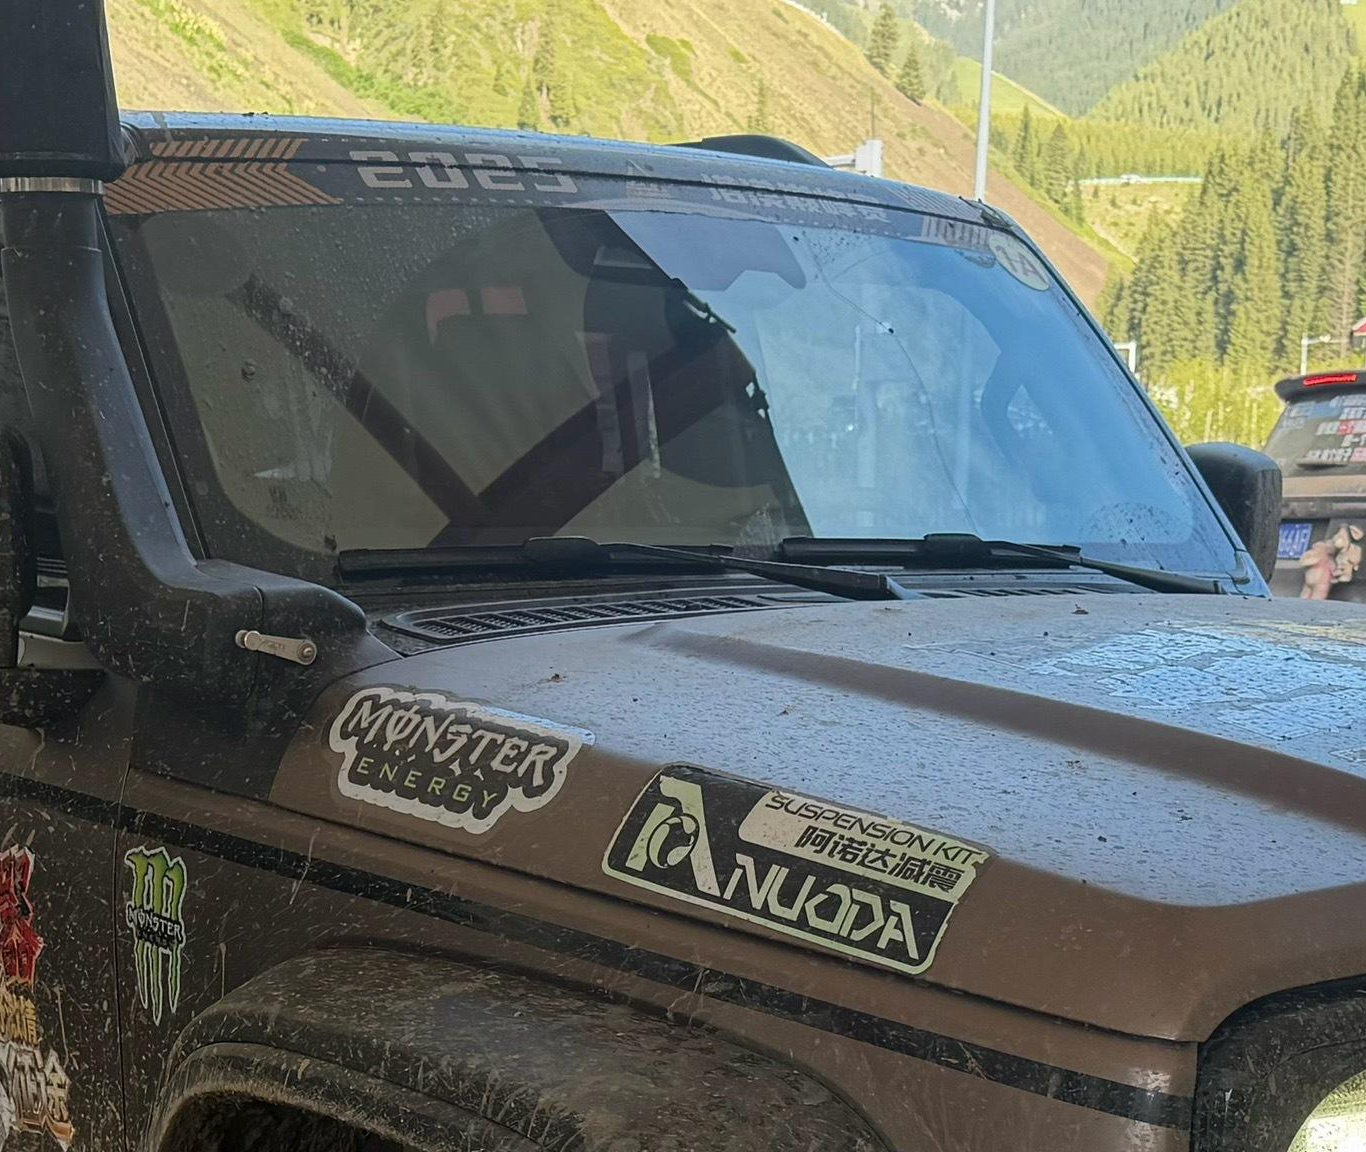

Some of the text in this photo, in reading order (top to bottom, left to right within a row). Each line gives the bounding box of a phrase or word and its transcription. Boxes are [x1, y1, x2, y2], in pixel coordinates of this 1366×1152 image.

[349, 150, 577, 194] 2025
[357, 756, 499, 808] ENERGY
[765, 792, 984, 866] SUSPENSION KIT
[794, 824, 965, 893] 阿诺达减震
